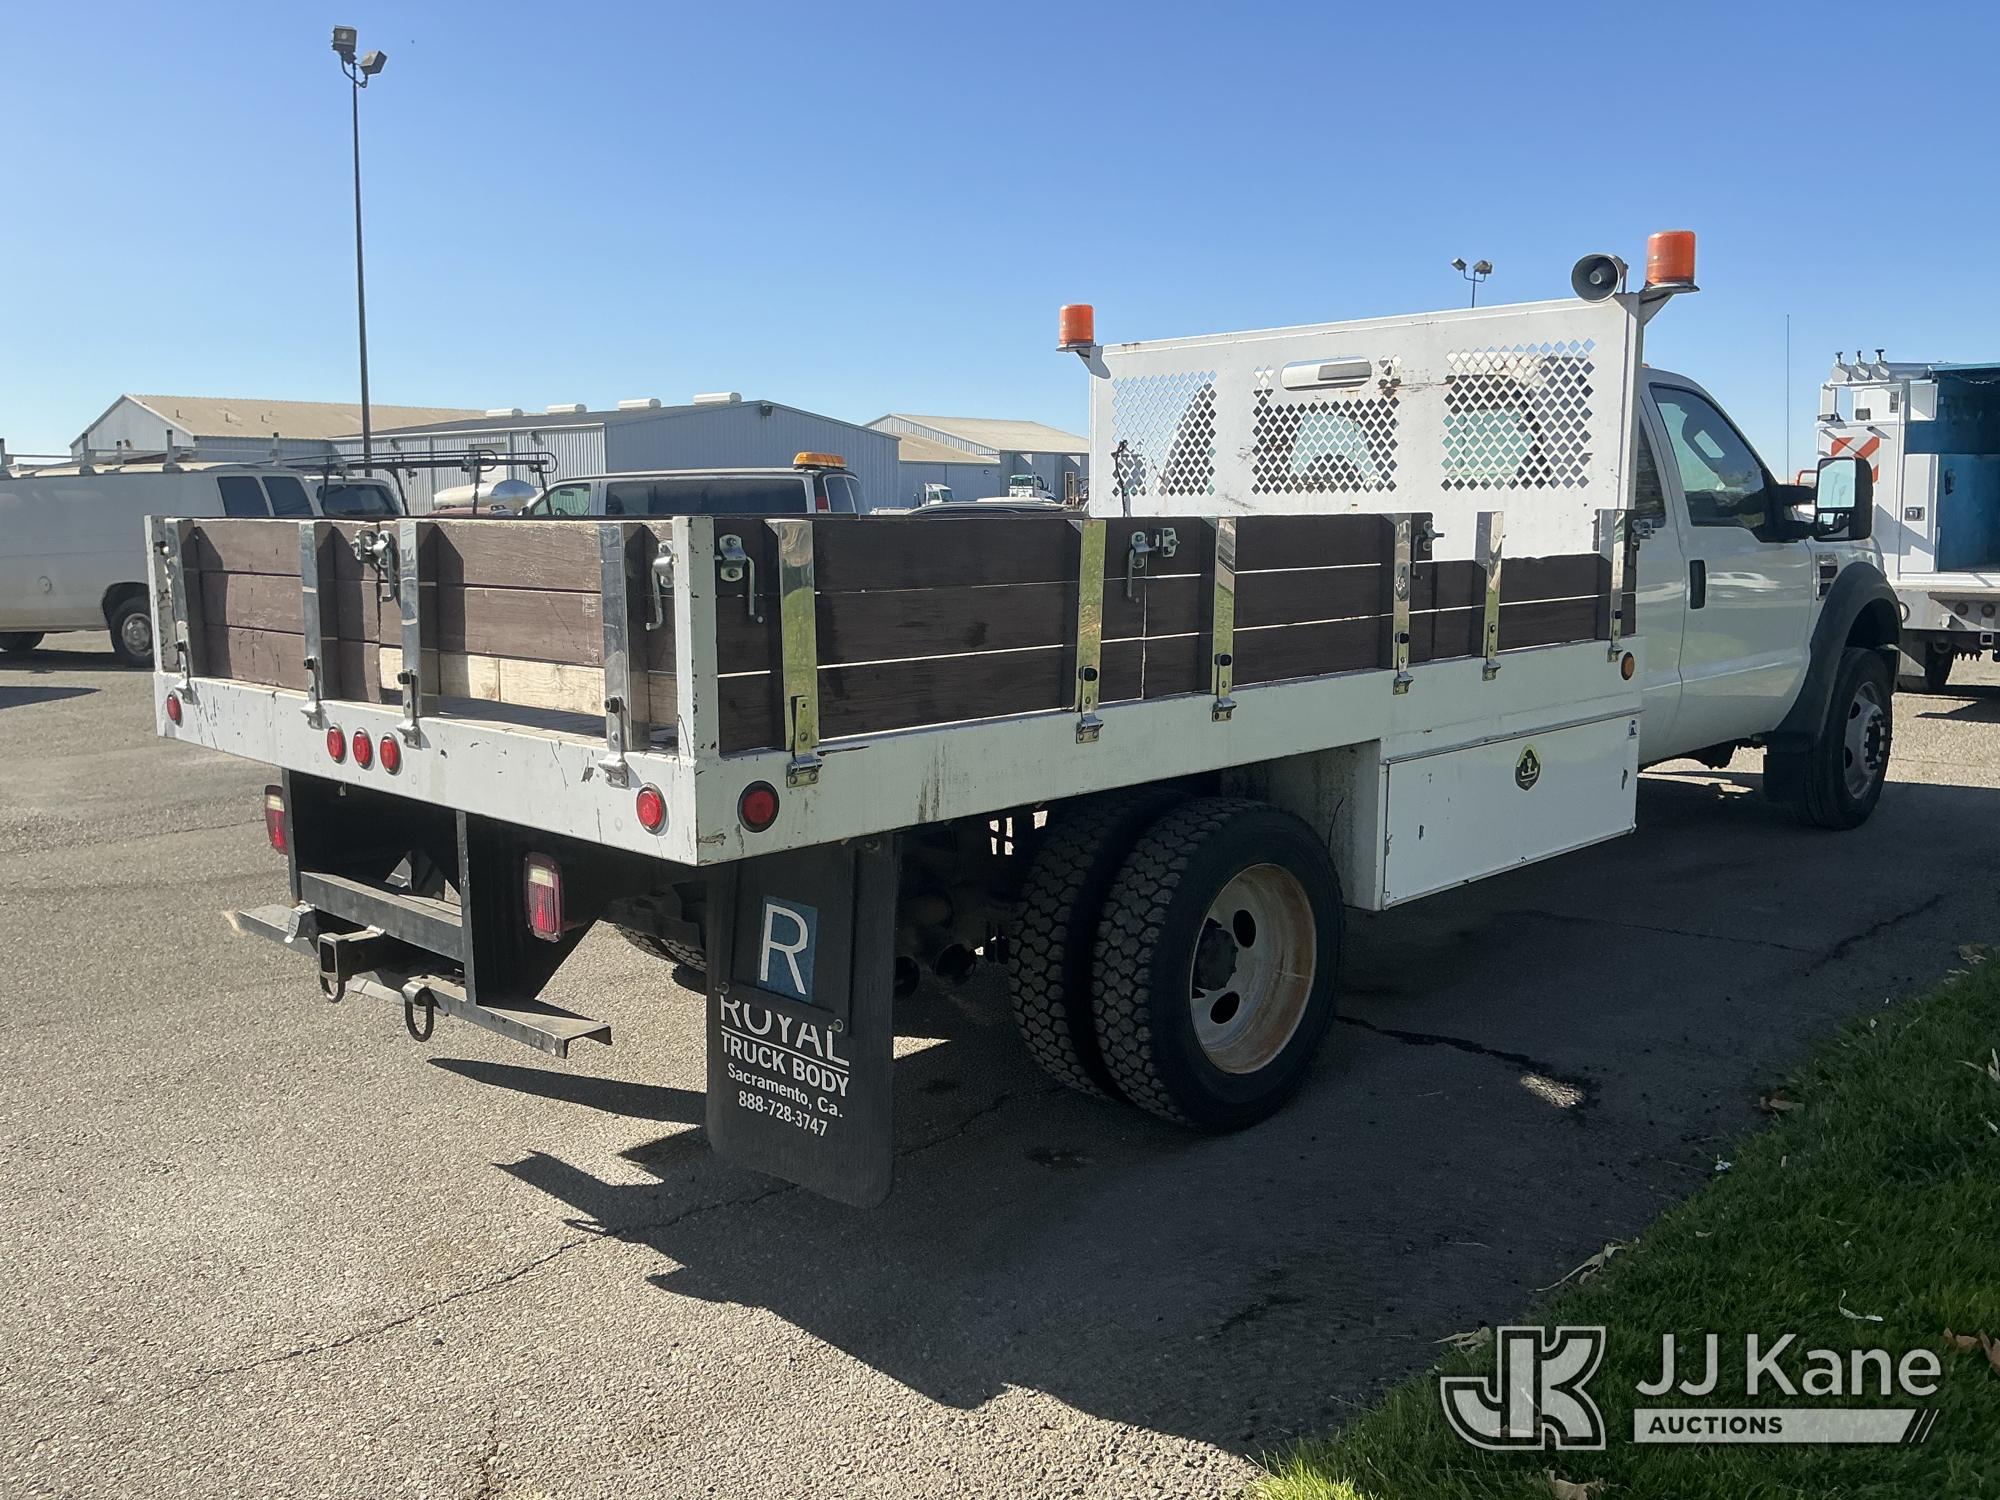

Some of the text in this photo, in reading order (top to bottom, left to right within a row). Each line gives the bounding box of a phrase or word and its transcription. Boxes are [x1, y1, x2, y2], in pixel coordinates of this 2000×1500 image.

[760, 903, 808, 995] R
[720, 994, 850, 1067] ROYAL
[721, 1031, 849, 1097] TRUCK BODY
[727, 1062, 843, 1118] Sacramento, Ca.
[738, 1090, 828, 1137] 888-728-3747
